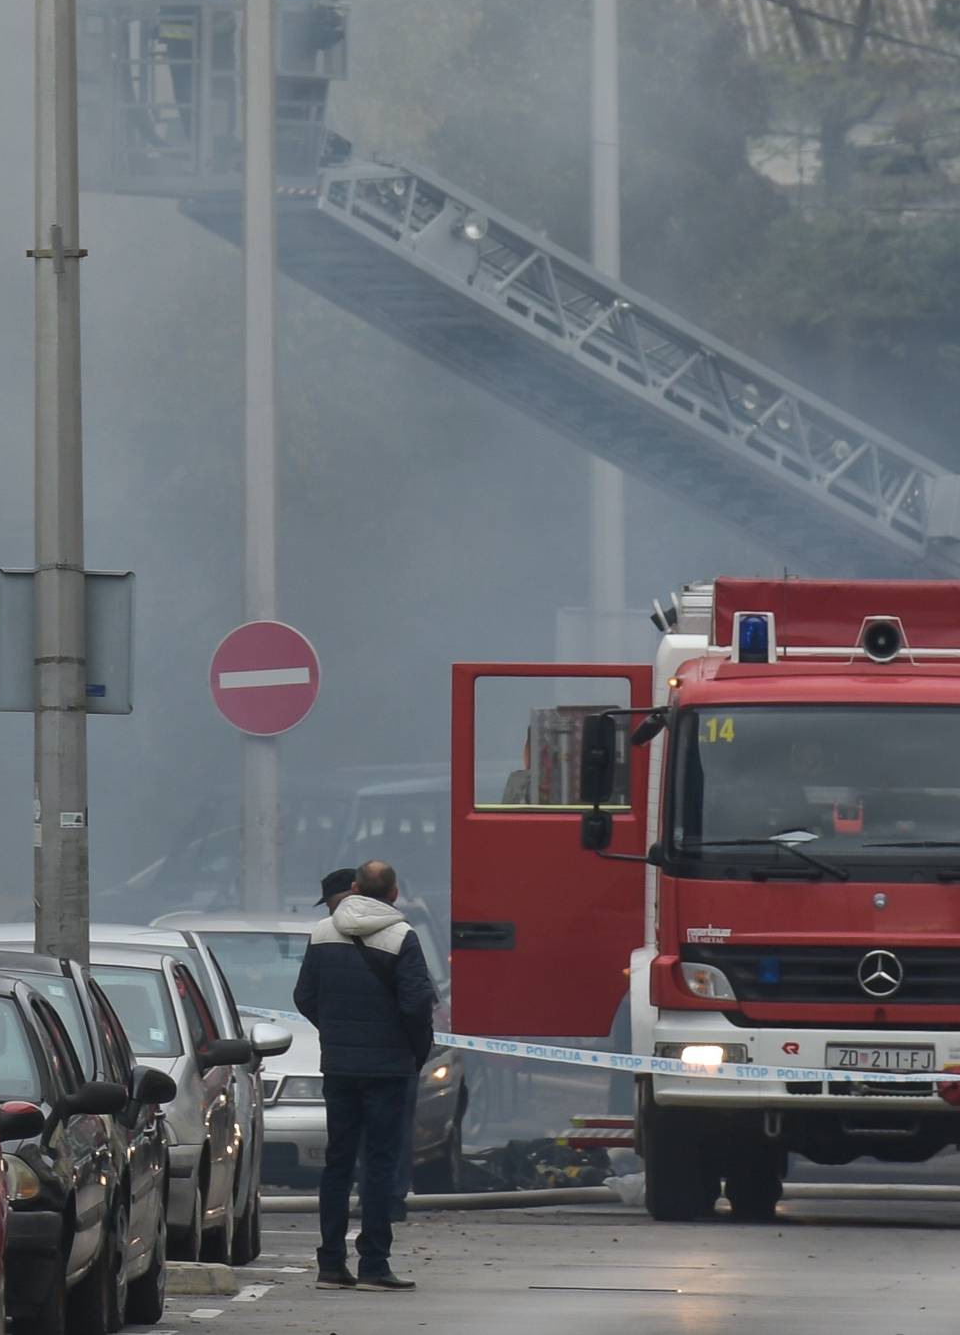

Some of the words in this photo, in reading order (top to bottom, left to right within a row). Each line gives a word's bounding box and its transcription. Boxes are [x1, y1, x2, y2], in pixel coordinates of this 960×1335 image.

[486, 1041, 518, 1054] STOP
[526, 1045, 583, 1062] POLICIJA
[609, 1055, 642, 1067] STOP
[735, 1067, 769, 1079] STOP
[776, 1068, 835, 1082] POLICIJA
[839, 1049, 859, 1067] ZD
[871, 1050, 931, 1070] 211-FJ
